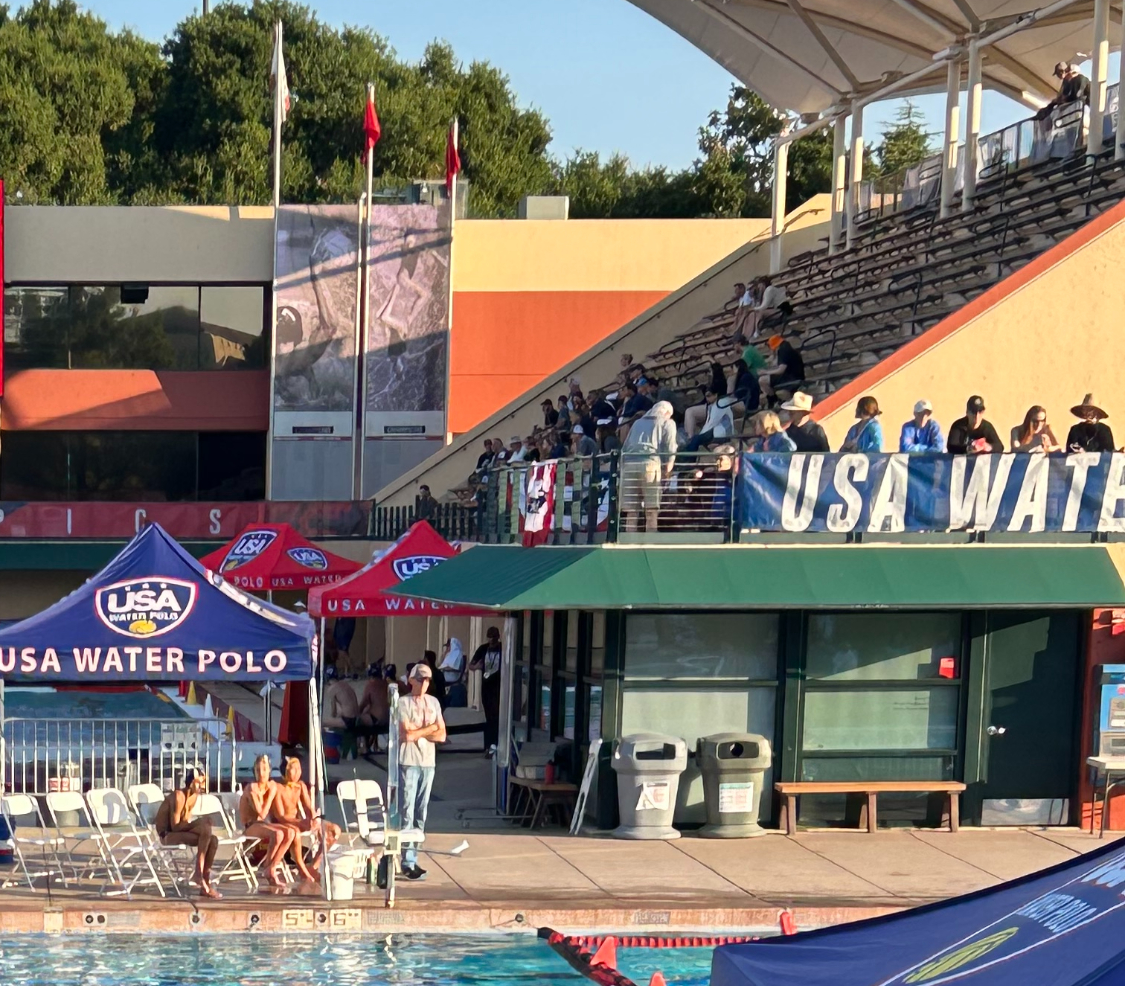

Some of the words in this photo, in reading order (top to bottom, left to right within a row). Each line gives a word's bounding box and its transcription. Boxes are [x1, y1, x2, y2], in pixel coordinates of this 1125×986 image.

[781, 453, 909, 532] USA
[233, 575, 264, 588] POLO
[271, 577, 294, 586] USA
[108, 589, 181, 613] USA
[327, 599, 366, 612] USA
[72, 647, 186, 674] WATER
[197, 648, 288, 674] POLO
